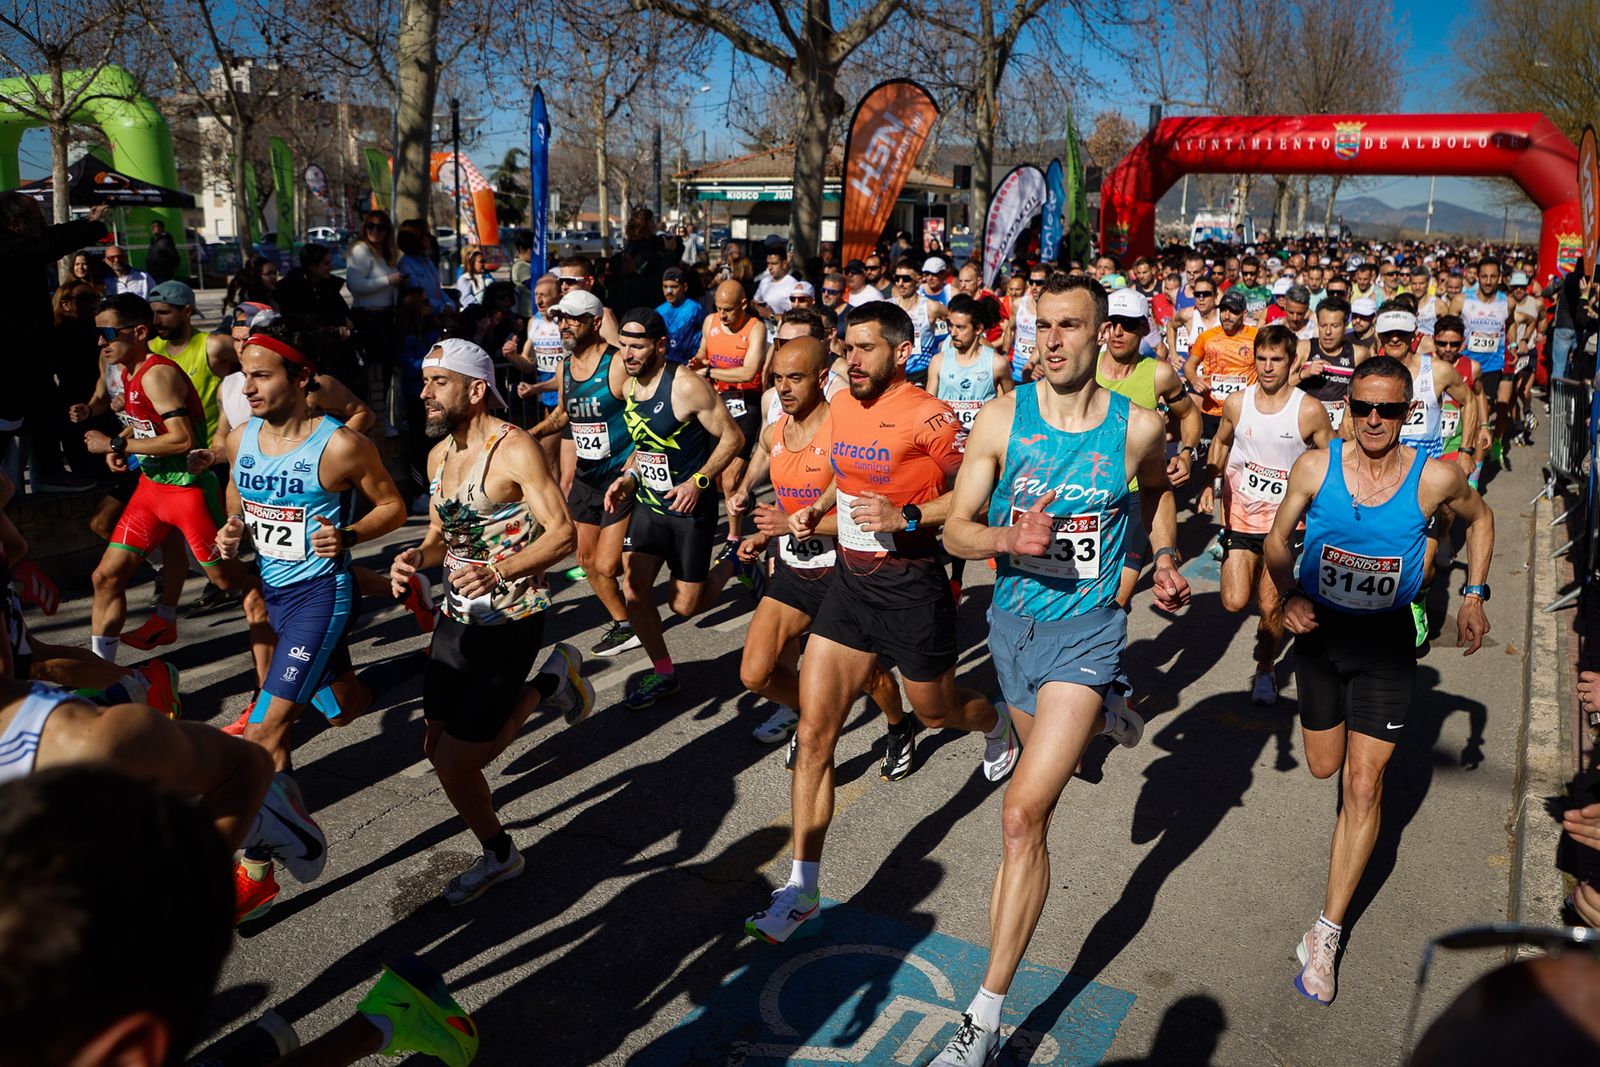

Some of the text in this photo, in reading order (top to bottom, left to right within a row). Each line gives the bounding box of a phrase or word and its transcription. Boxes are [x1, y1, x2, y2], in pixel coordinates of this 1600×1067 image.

[1173, 137, 1331, 151] AYUNTAMIENTO
[1364, 136, 1388, 150] DE
[851, 111, 905, 198] HSN
[726, 191, 760, 200] KIOSCO
[1473, 338, 1495, 348] 239
[567, 396, 602, 418] Giit
[576, 436, 602, 450] 624
[832, 440, 891, 462] atracón
[855, 461, 891, 474] running
[238, 470, 305, 498] nerja
[777, 483, 822, 499] atracón
[1248, 474, 1283, 495] 976
[253, 506, 285, 521] FONDO
[251, 520, 293, 547] 172
[1327, 550, 1340, 560] 39
[1338, 556, 1381, 571] FONDO
[1321, 565, 1396, 597] 3140
